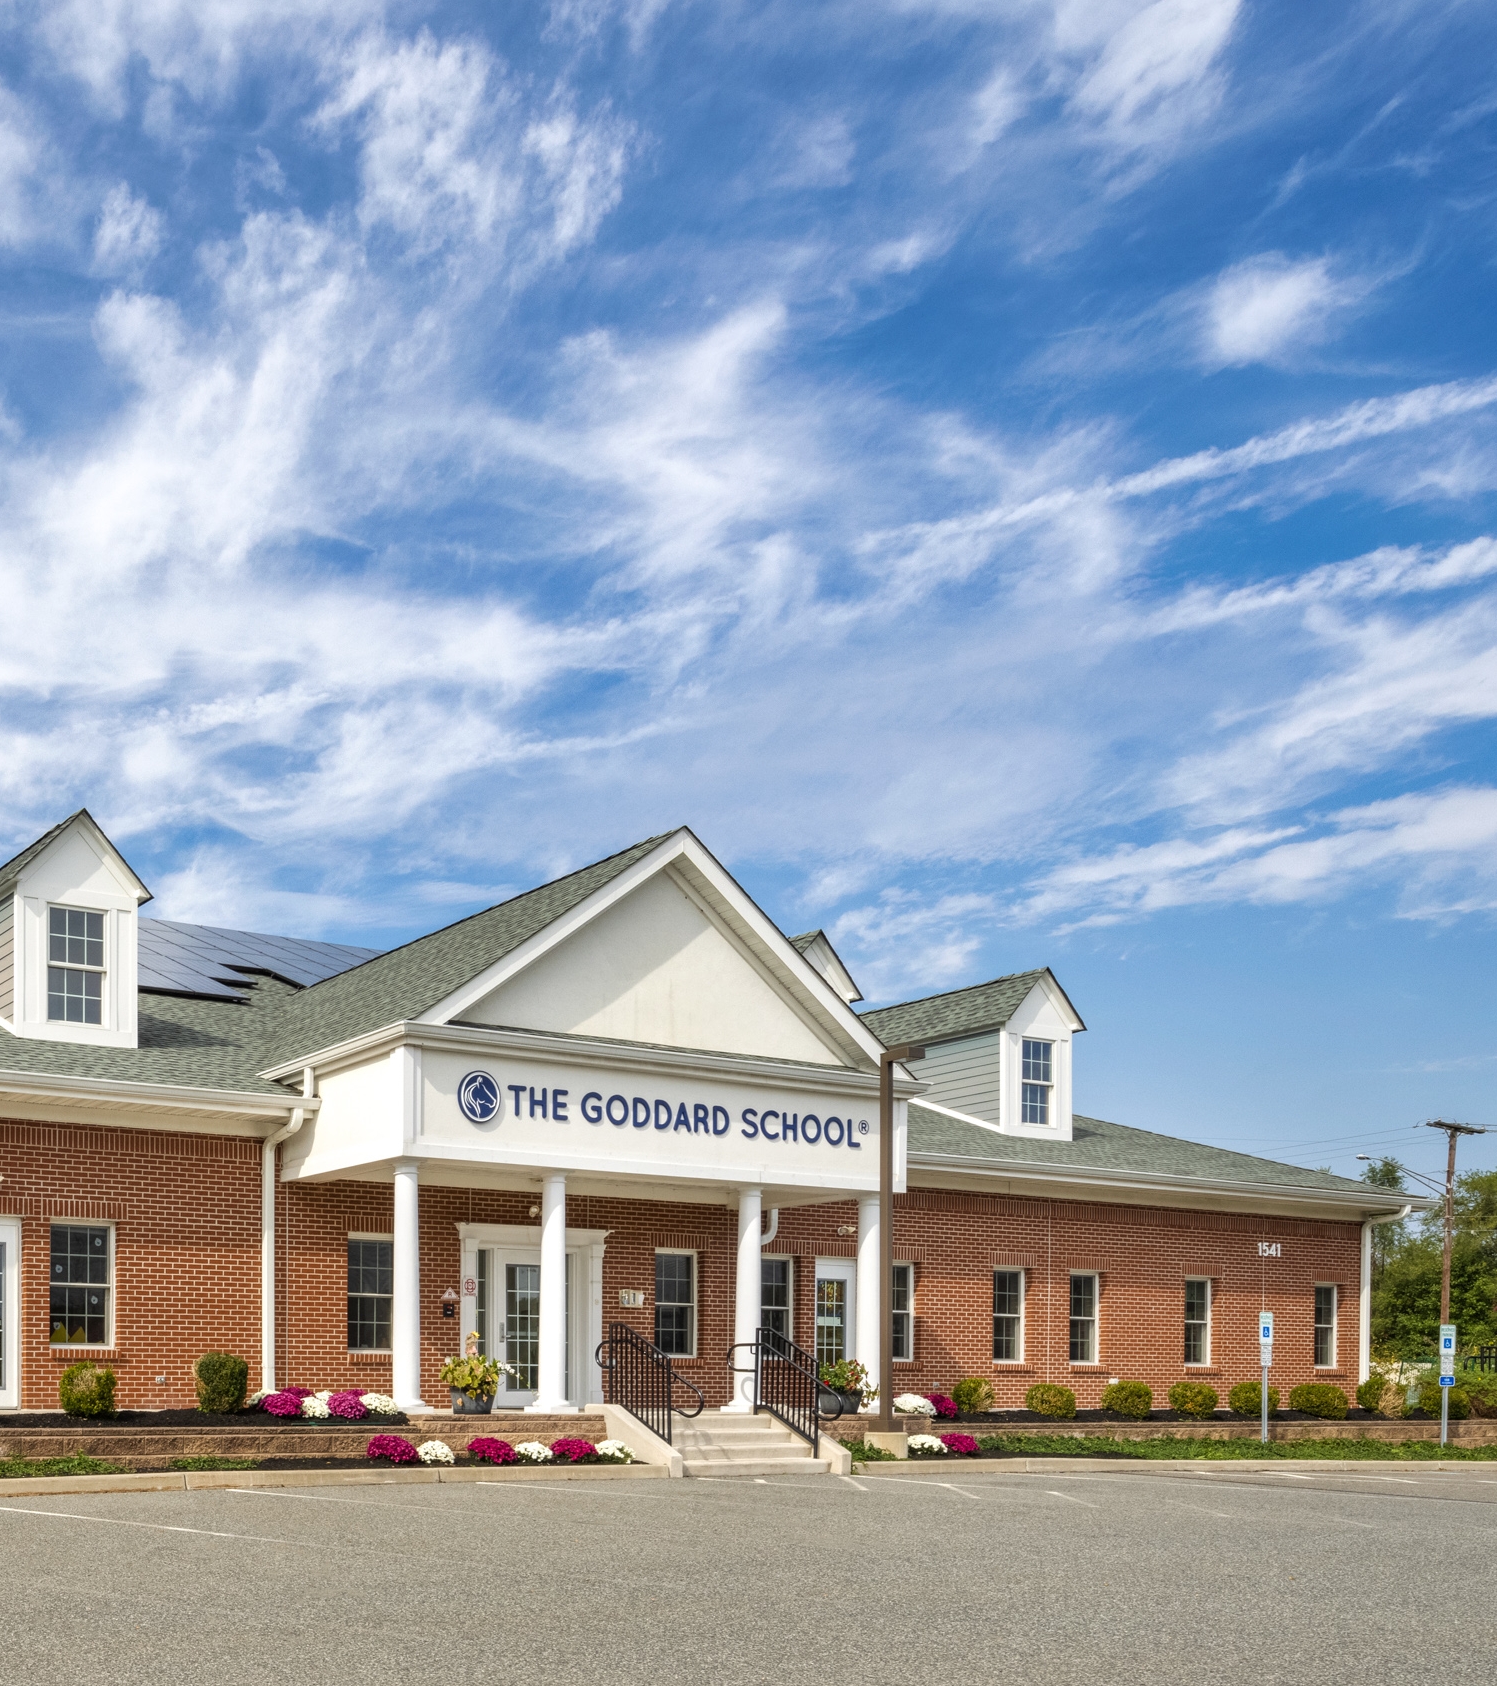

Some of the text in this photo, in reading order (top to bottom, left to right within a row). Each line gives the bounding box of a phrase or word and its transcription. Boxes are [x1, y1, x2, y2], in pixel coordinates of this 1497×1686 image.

[507, 1085, 569, 1121] THE
[580, 1091, 730, 1136] GODDARD
[1257, 1242, 1281, 1258] 1541
